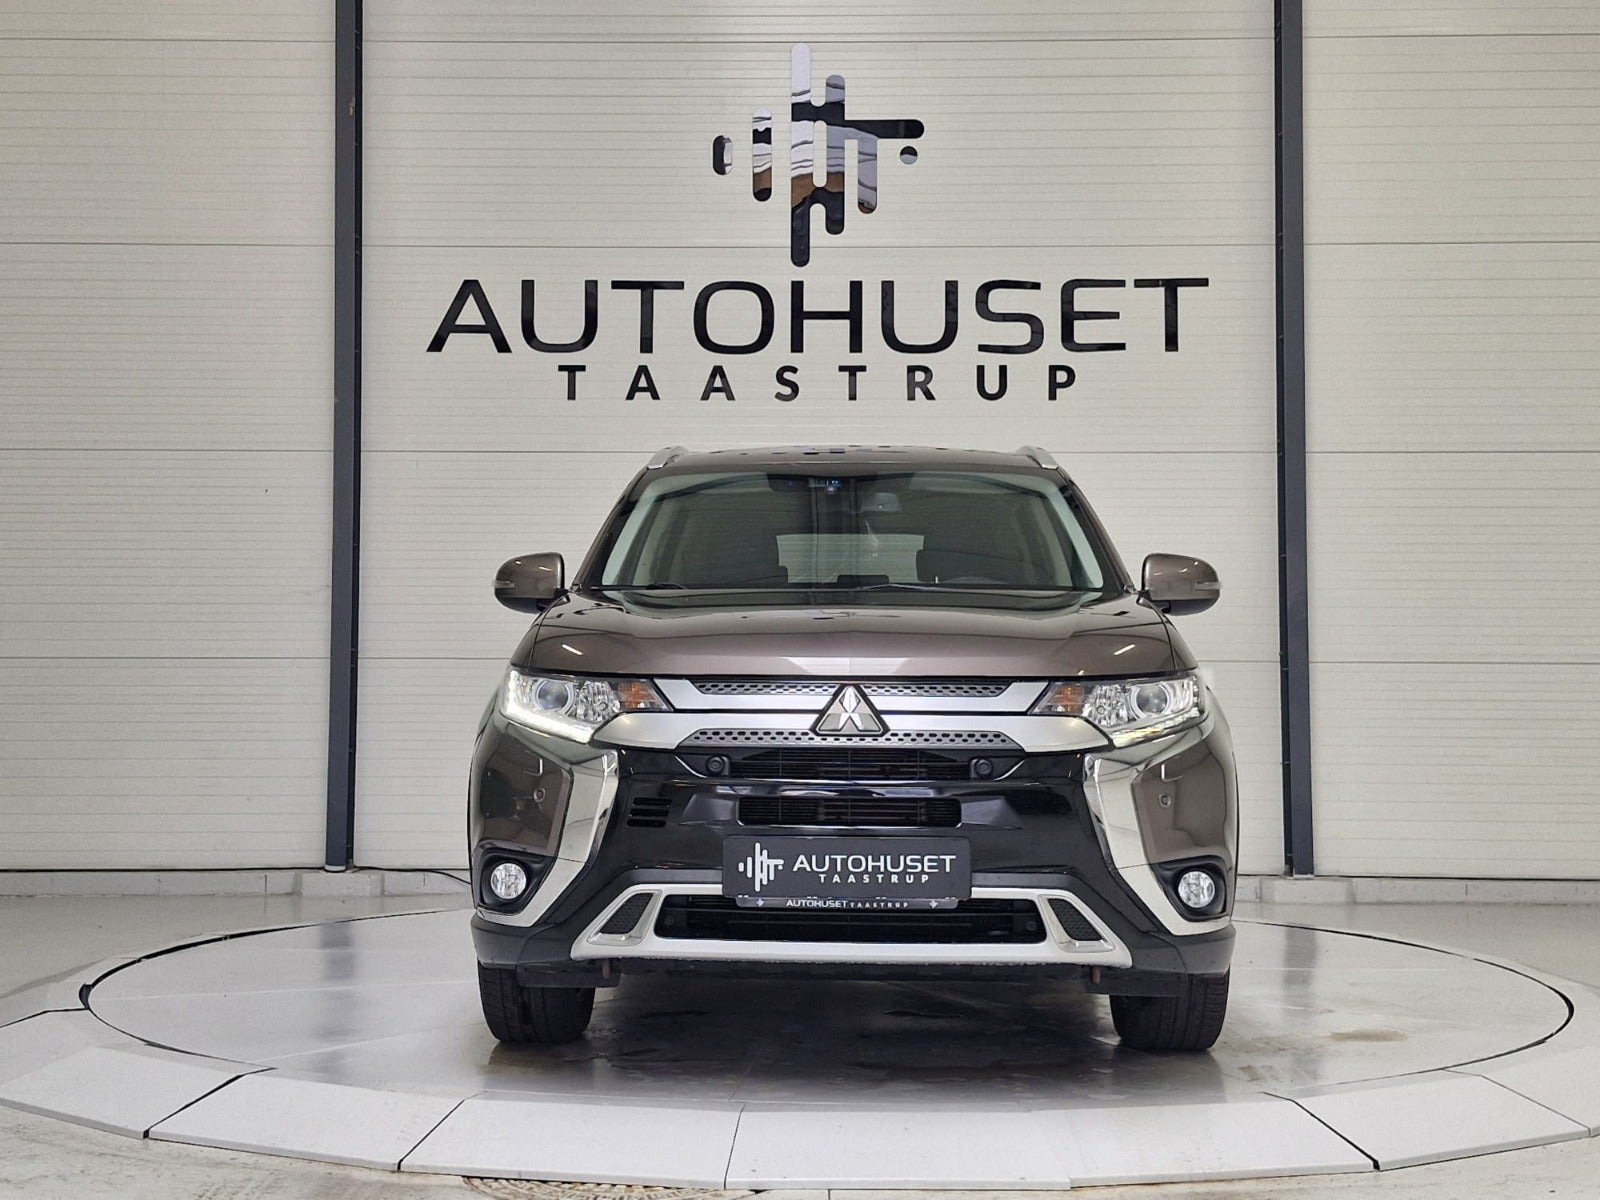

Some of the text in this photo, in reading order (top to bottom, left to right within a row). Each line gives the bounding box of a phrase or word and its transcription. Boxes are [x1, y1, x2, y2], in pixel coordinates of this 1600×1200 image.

[426, 277, 1209, 354] AUTOHUSET
[558, 365, 1076, 402] TAASTRUP
[792, 854, 956, 873] AUTOHUSET
[818, 874, 929, 884] TAASTRUP
[786, 899, 909, 909] AUTOHUSET TAASTRUP
